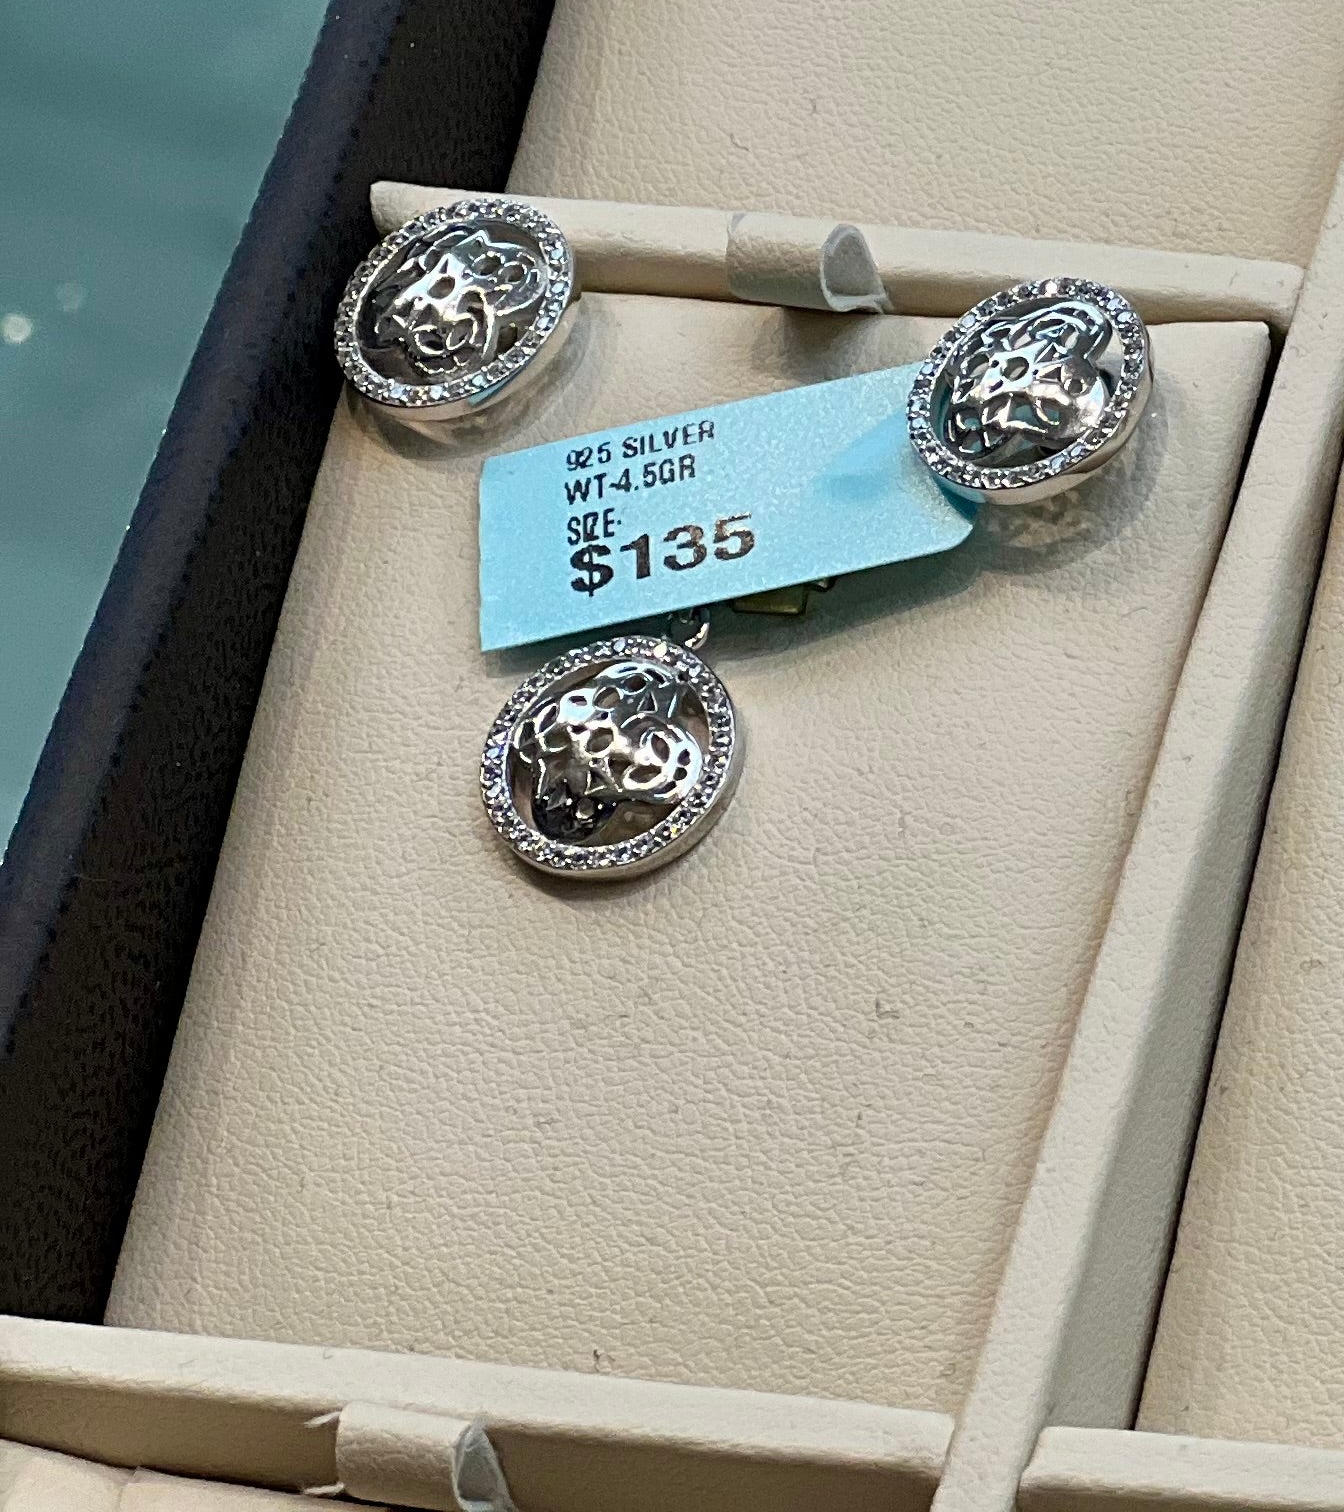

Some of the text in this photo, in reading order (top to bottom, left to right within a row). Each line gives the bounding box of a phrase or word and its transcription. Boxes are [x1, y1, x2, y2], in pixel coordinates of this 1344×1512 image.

[566, 419, 715, 471] 925 SILVER
[570, 513, 755, 598] $135
